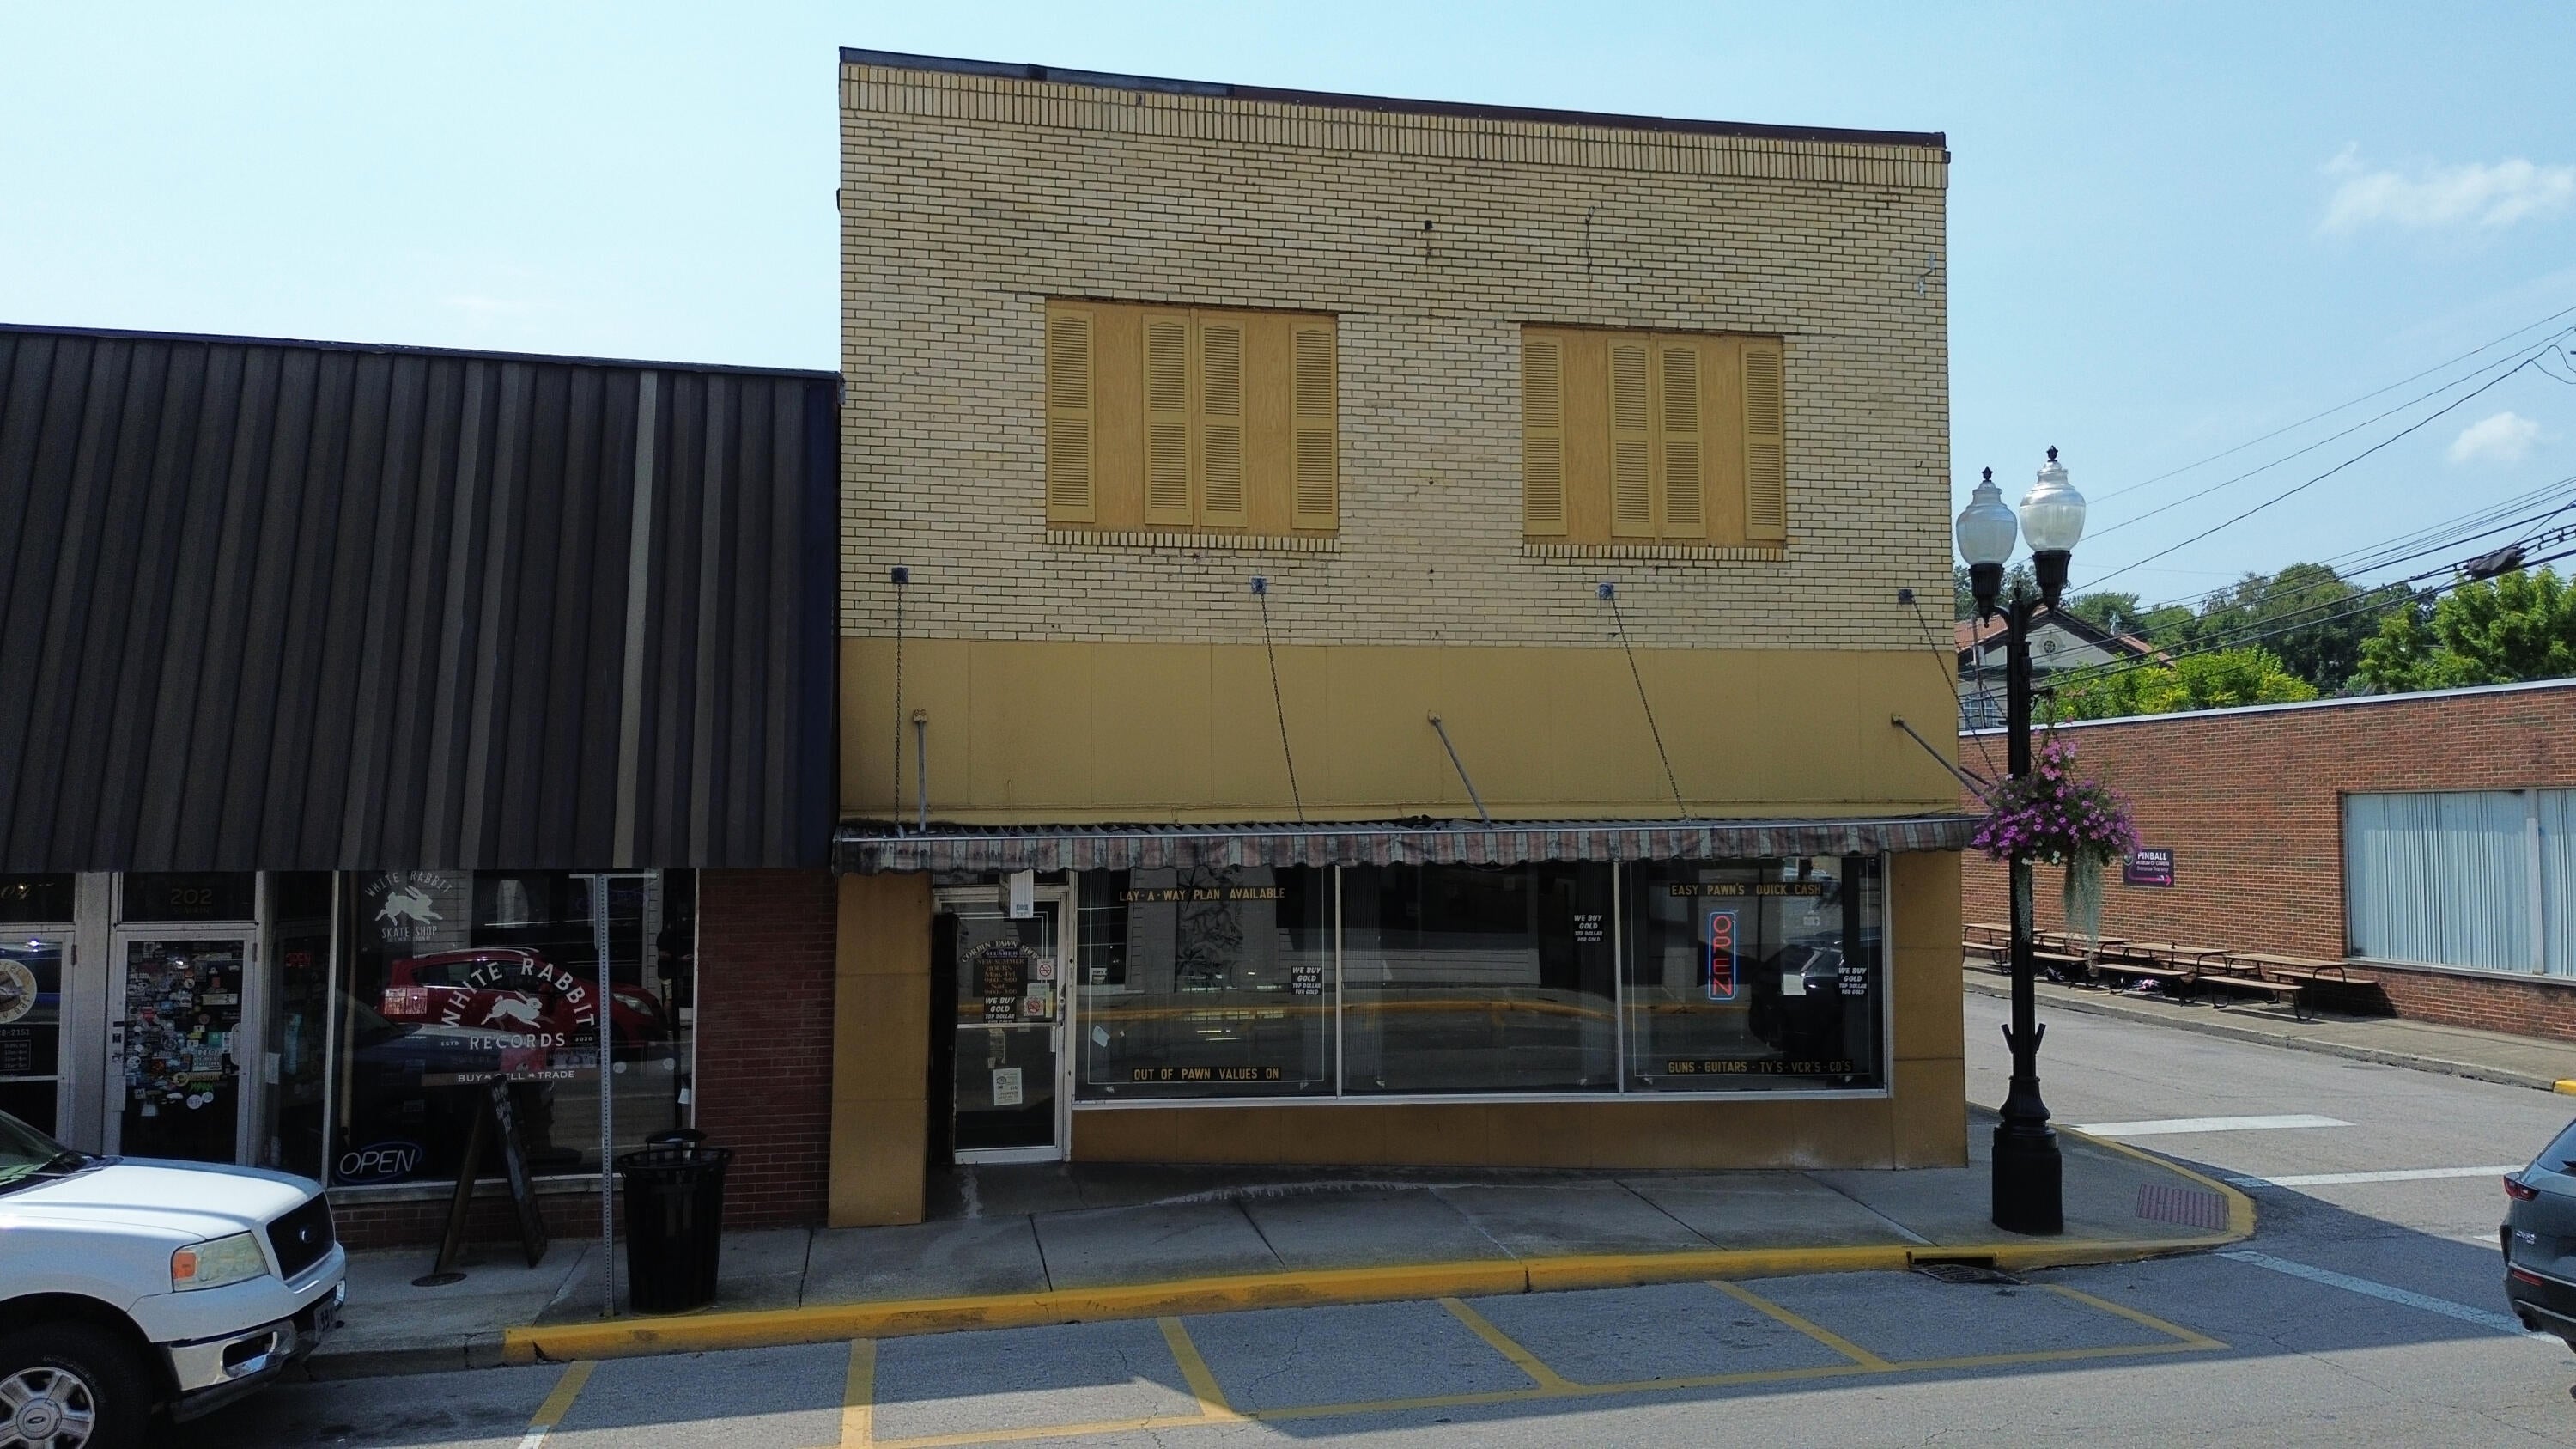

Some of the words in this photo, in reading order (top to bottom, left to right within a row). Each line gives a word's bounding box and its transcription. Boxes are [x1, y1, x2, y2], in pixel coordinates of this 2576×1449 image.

[2138, 852, 2167, 860] PINBALL
[365, 872, 400, 898] WHITE
[410, 870, 453, 893] RABBIT
[1671, 885, 1699, 895] EASY
[1707, 883, 1745, 895] PAWN'S
[1756, 884, 1787, 895] QUICK
[1795, 884, 1822, 895] CASH
[171, 888, 213, 905] 202
[1193, 888, 1221, 900] PLAN
[1229, 887, 1285, 900] AVAILABLE
[381, 927, 410, 939] SKATE
[415, 925, 437, 937] SHOP
[962, 941, 991, 962] CORBIN
[1021, 945, 1040, 960] SHOP
[1713, 915, 1732, 996] OPEN
[439, 962, 503, 1030] WHITE
[521, 957, 595, 1027] RABBIT
[470, 1032, 566, 1050] RECORDS
[1134, 1068, 1154, 1080] OUT
[1160, 1068, 1173, 1080] OF
[1181, 1068, 1211, 1079] PAWN
[1219, 1068, 1258, 1079] VALUES
[1265, 1068, 1279, 1079] ON
[1668, 1062, 1695, 1073] GUNS
[1704, 1061, 1748, 1072] GUITARS
[1760, 1061, 1783, 1072] TV'S
[1791, 1061, 1821, 1072] VCR'S
[458, 1074, 483, 1082] BUY
[538, 1070, 575, 1079] TRADE
[339, 1149, 416, 1175] OPEN
